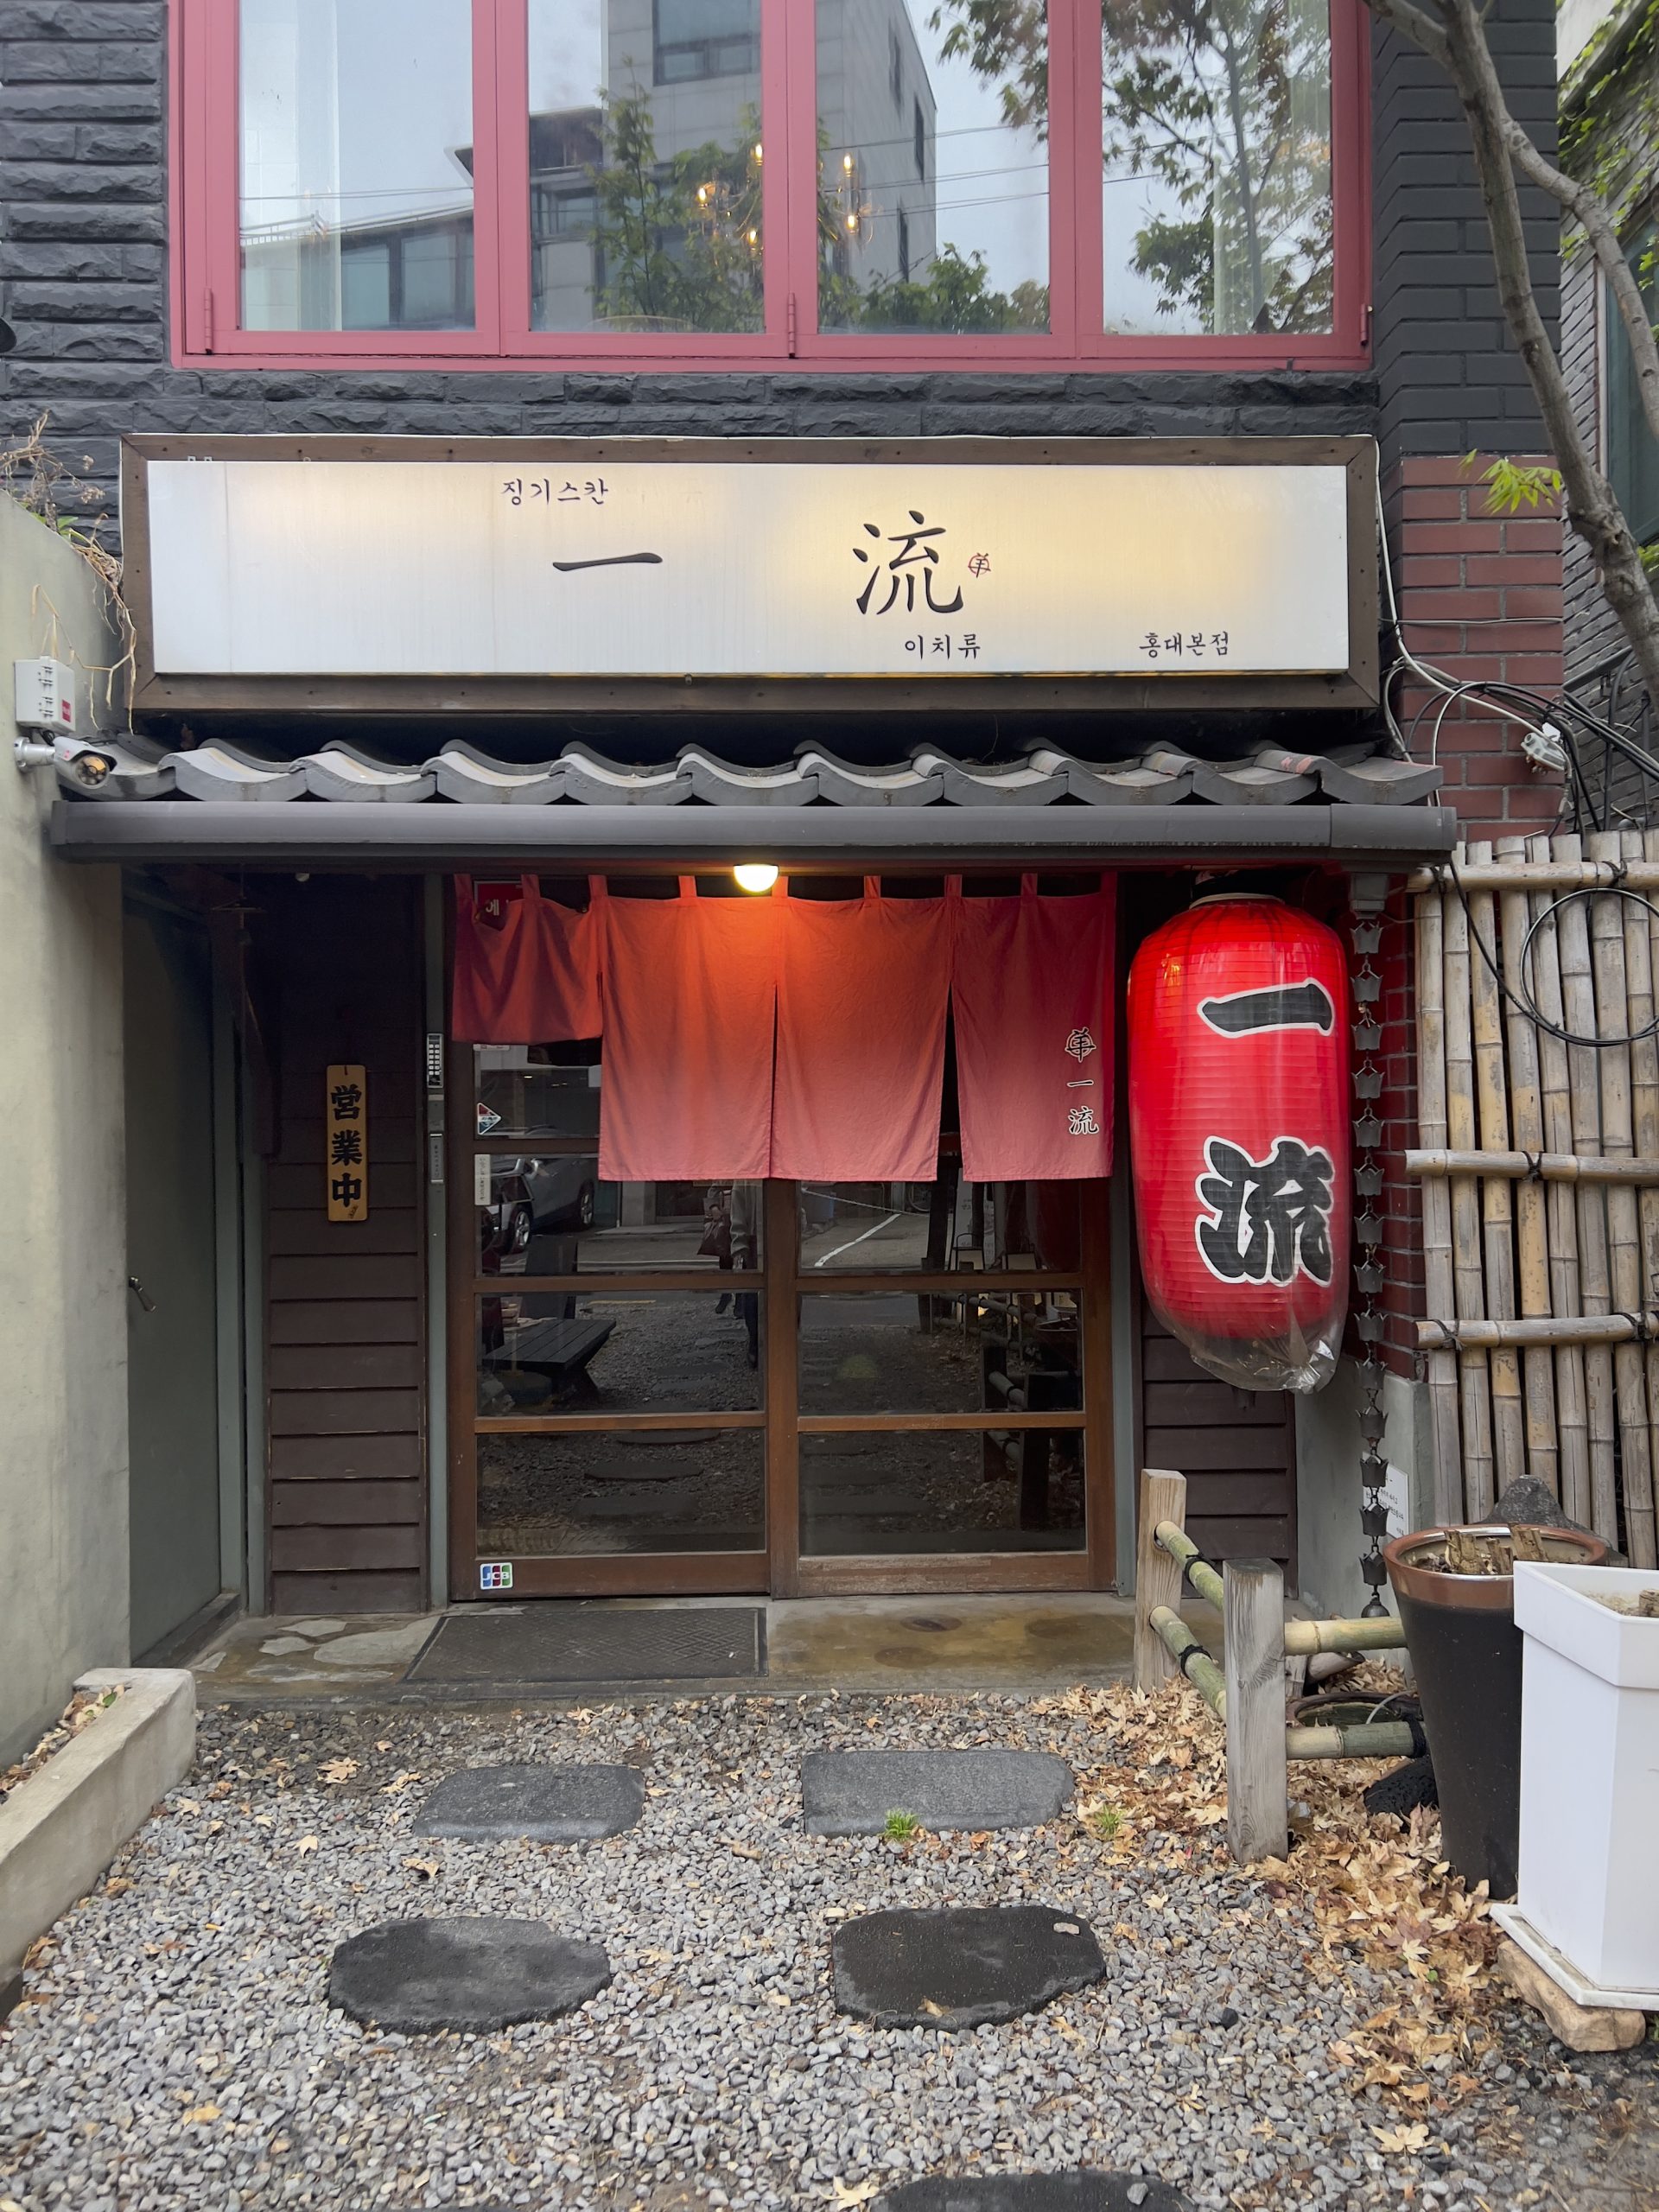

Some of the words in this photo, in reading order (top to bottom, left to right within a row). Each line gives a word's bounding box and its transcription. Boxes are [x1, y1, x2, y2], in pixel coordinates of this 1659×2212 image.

[501, 478, 610, 506] 징기스칸
[904, 632, 982, 660] 이치류
[1138, 631, 1230, 658] 홍대본점
[330, 1083, 363, 1208] 営業中
[1196, 978, 1335, 1287] 一流
[483, 1572, 510, 1580] JCB
